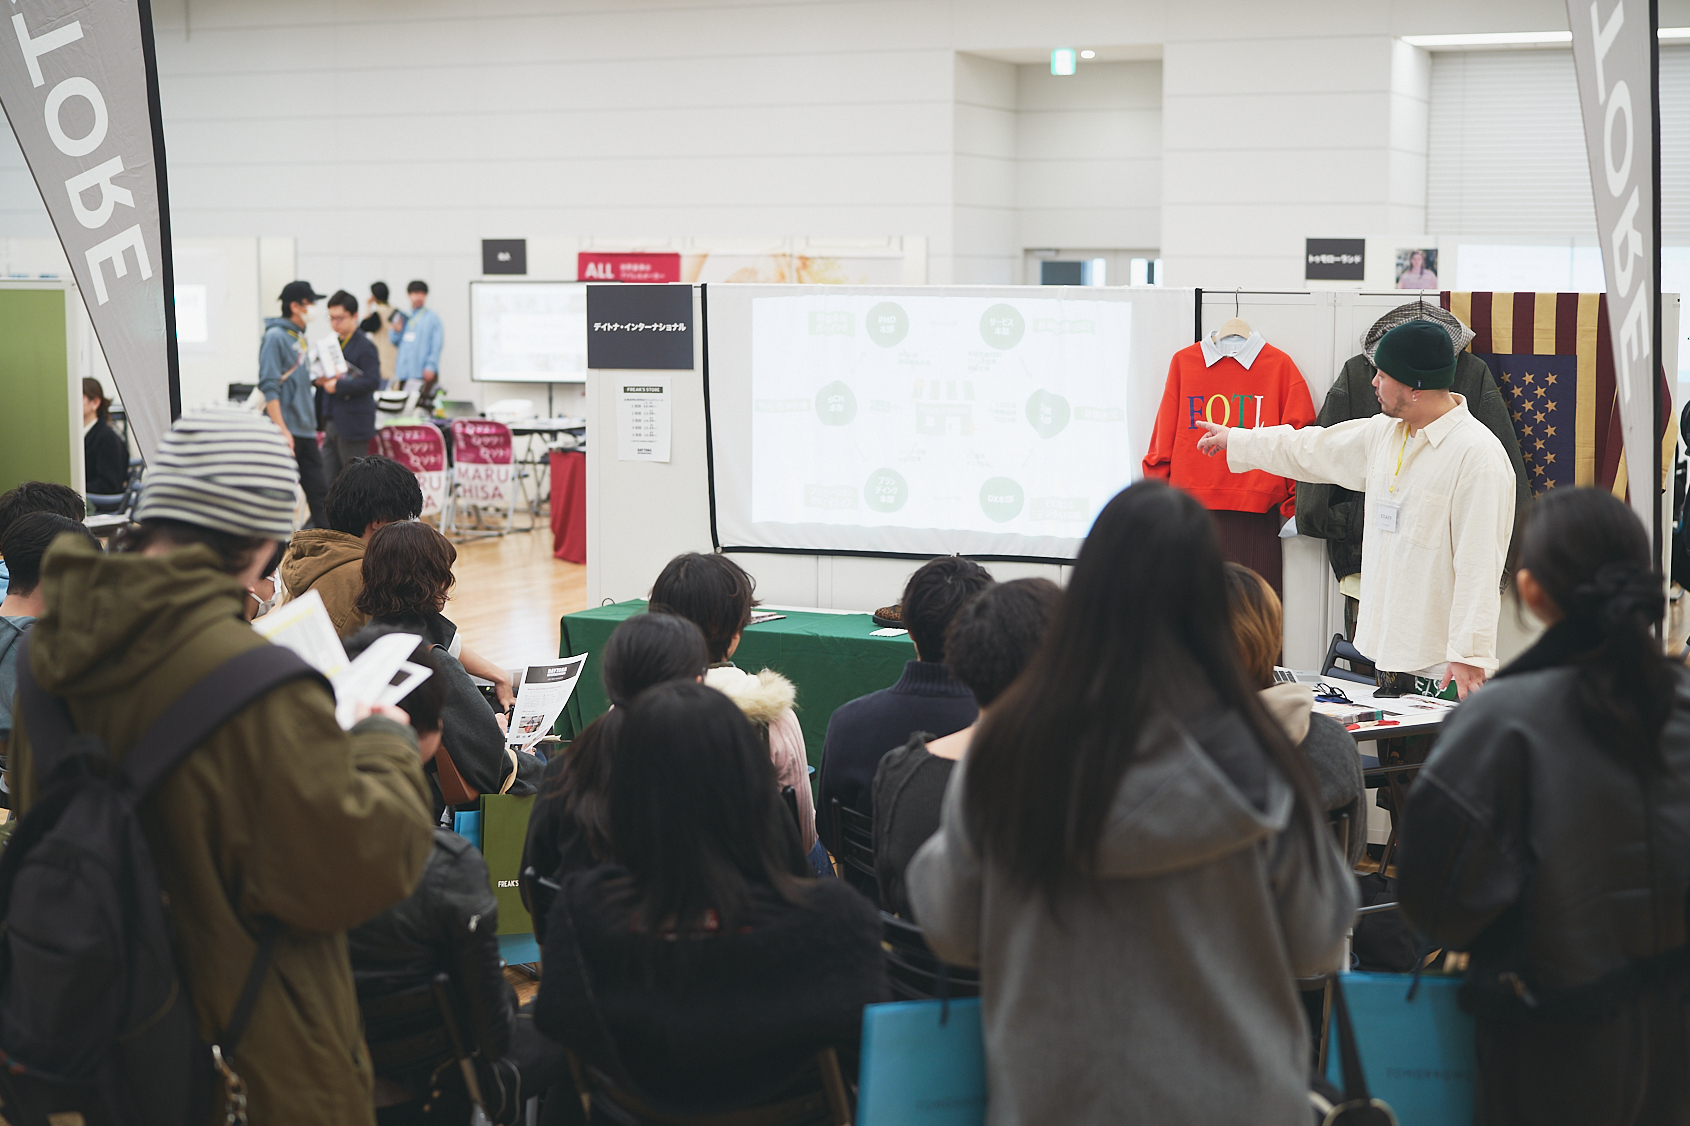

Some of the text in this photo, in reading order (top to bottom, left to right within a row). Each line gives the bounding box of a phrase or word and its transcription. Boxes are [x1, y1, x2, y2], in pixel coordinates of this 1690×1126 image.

[585, 262, 614, 279] ALL
[593, 322, 687, 332] デイトナ・インターナショナル
[990, 318, 1014, 327] サービス
[994, 327, 1010, 336] 本部
[457, 466, 509, 483] MARU
[418, 476, 442, 491] RU
[462, 484, 504, 499] HISA
[498, 880, 519, 888] FREAK'S
